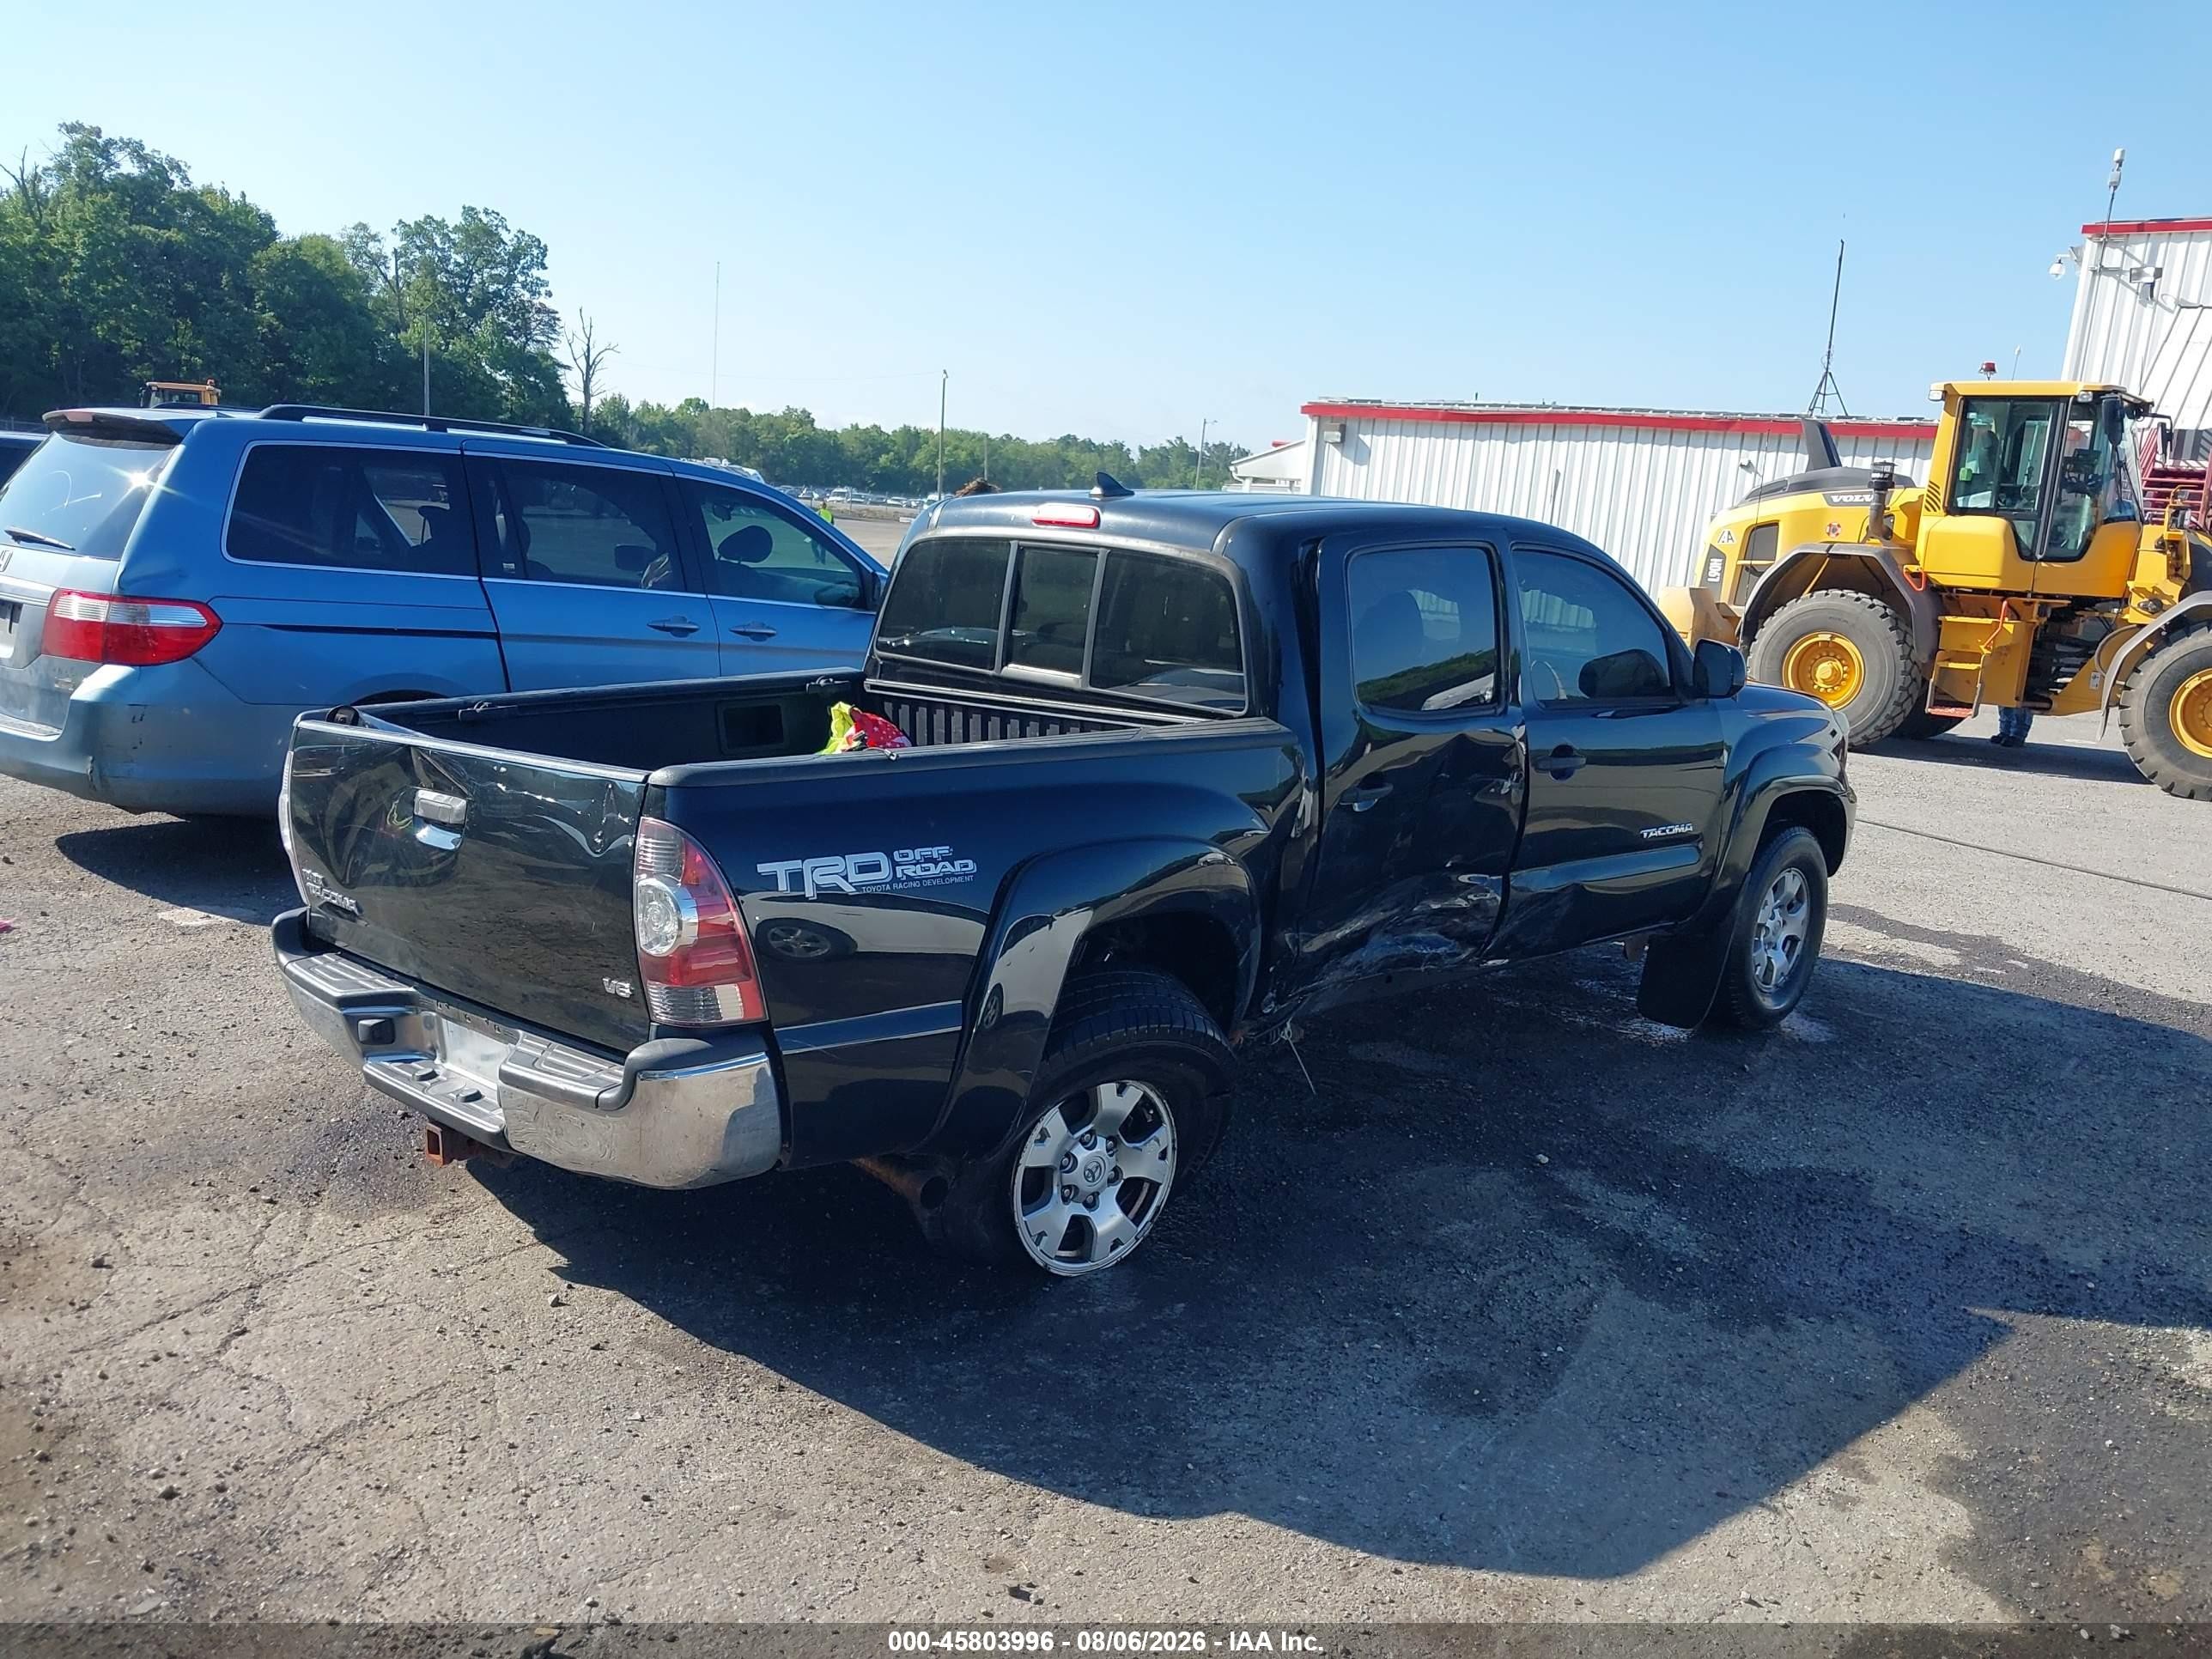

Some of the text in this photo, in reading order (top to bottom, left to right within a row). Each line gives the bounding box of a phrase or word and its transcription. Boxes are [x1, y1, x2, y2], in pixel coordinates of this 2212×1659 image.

[1831, 494, 1874, 503] VOLV
[1706, 558, 1723, 583] L90H
[1640, 823, 1693, 839] TACOMA
[757, 846, 953, 900] TRD OFF
[896, 859, 977, 880] ROAD
[861, 874, 975, 893] TOYOTA RACING DEVELOPMENT
[603, 977, 633, 998] V6
